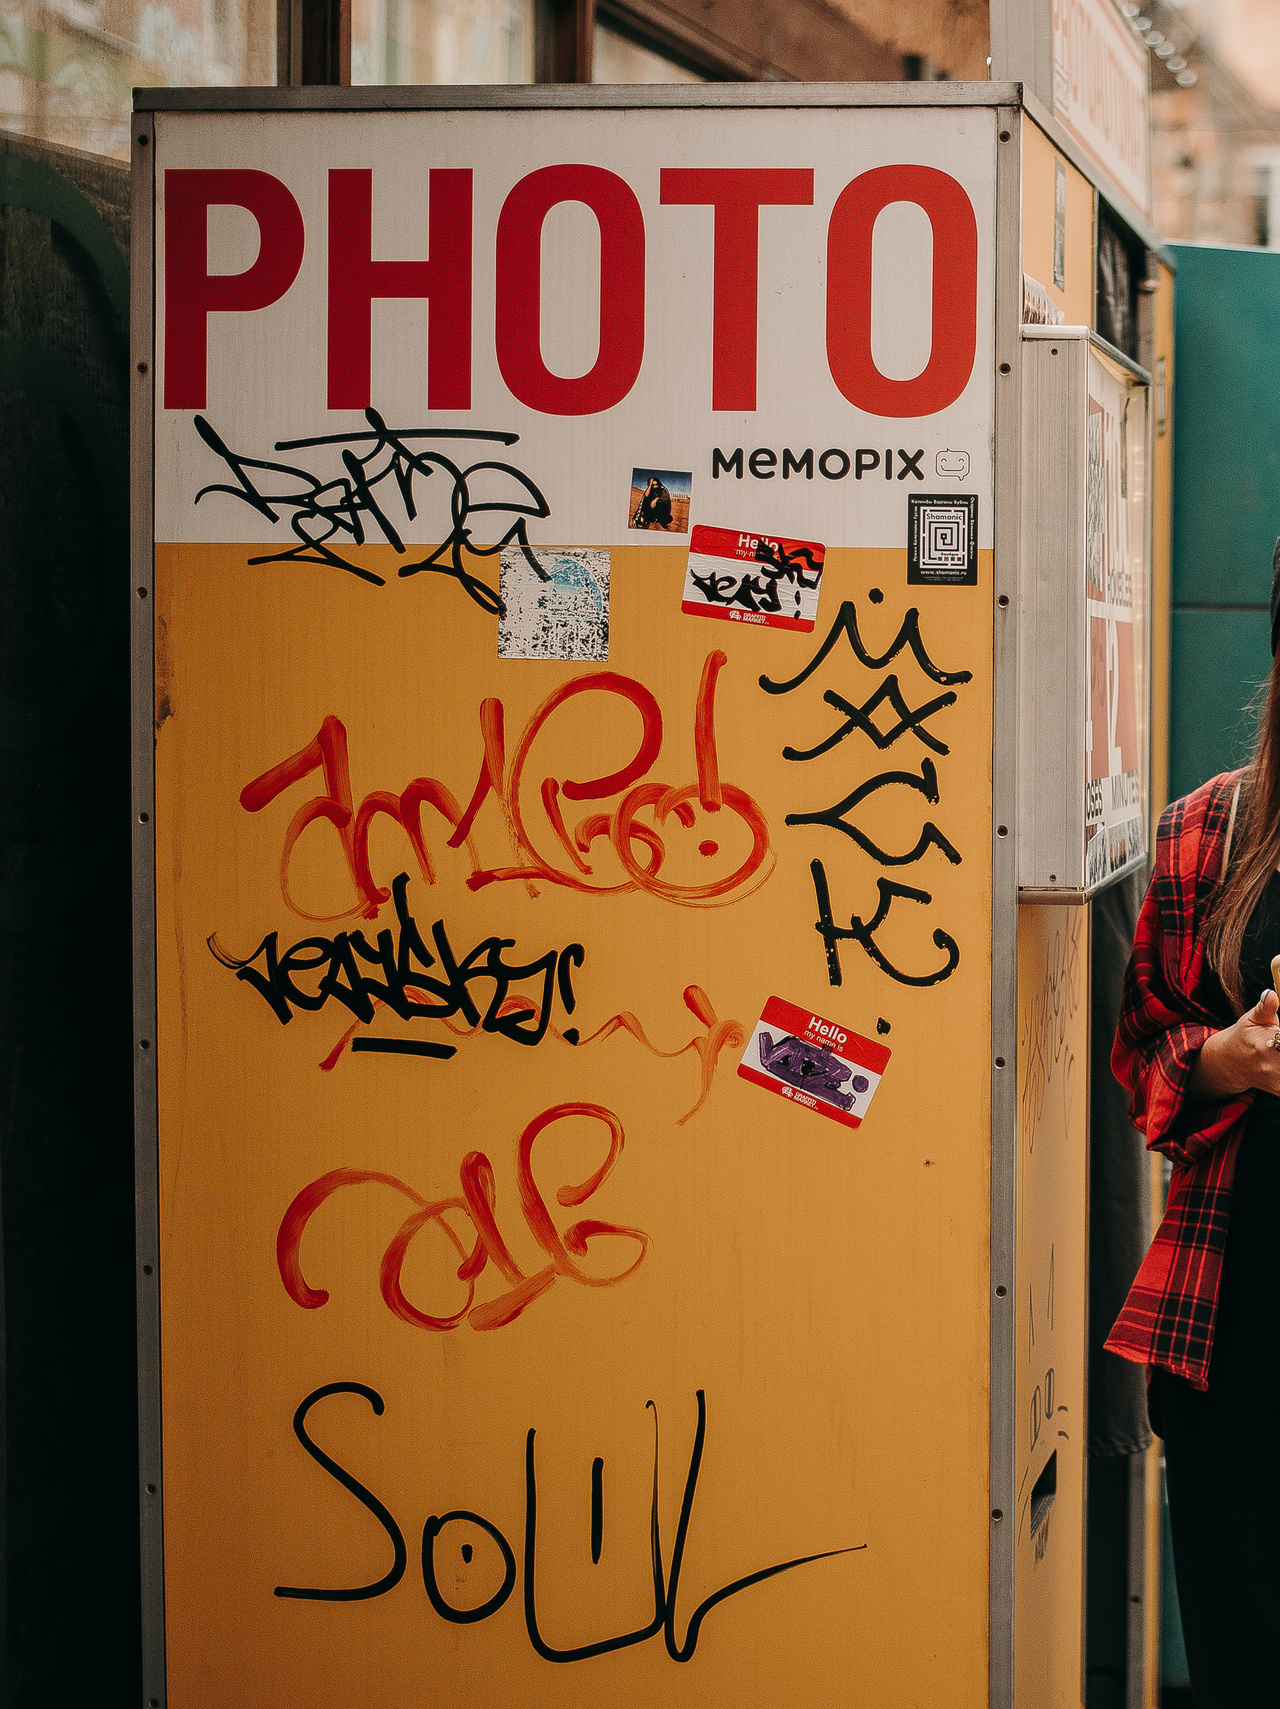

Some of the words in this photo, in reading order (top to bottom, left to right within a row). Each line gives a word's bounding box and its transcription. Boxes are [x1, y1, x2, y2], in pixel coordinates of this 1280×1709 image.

[163, 164, 978, 418] PHOTO
[926, 512, 962, 520] Shamanic
[738, 533, 779, 552] Helo
[1108, 618, 1122, 776] 2
[1086, 778, 1103, 820] OSES
[804, 1030, 816, 1039] my
[837, 1044, 844, 1052] is
[808, 1016, 847, 1043] Hello
